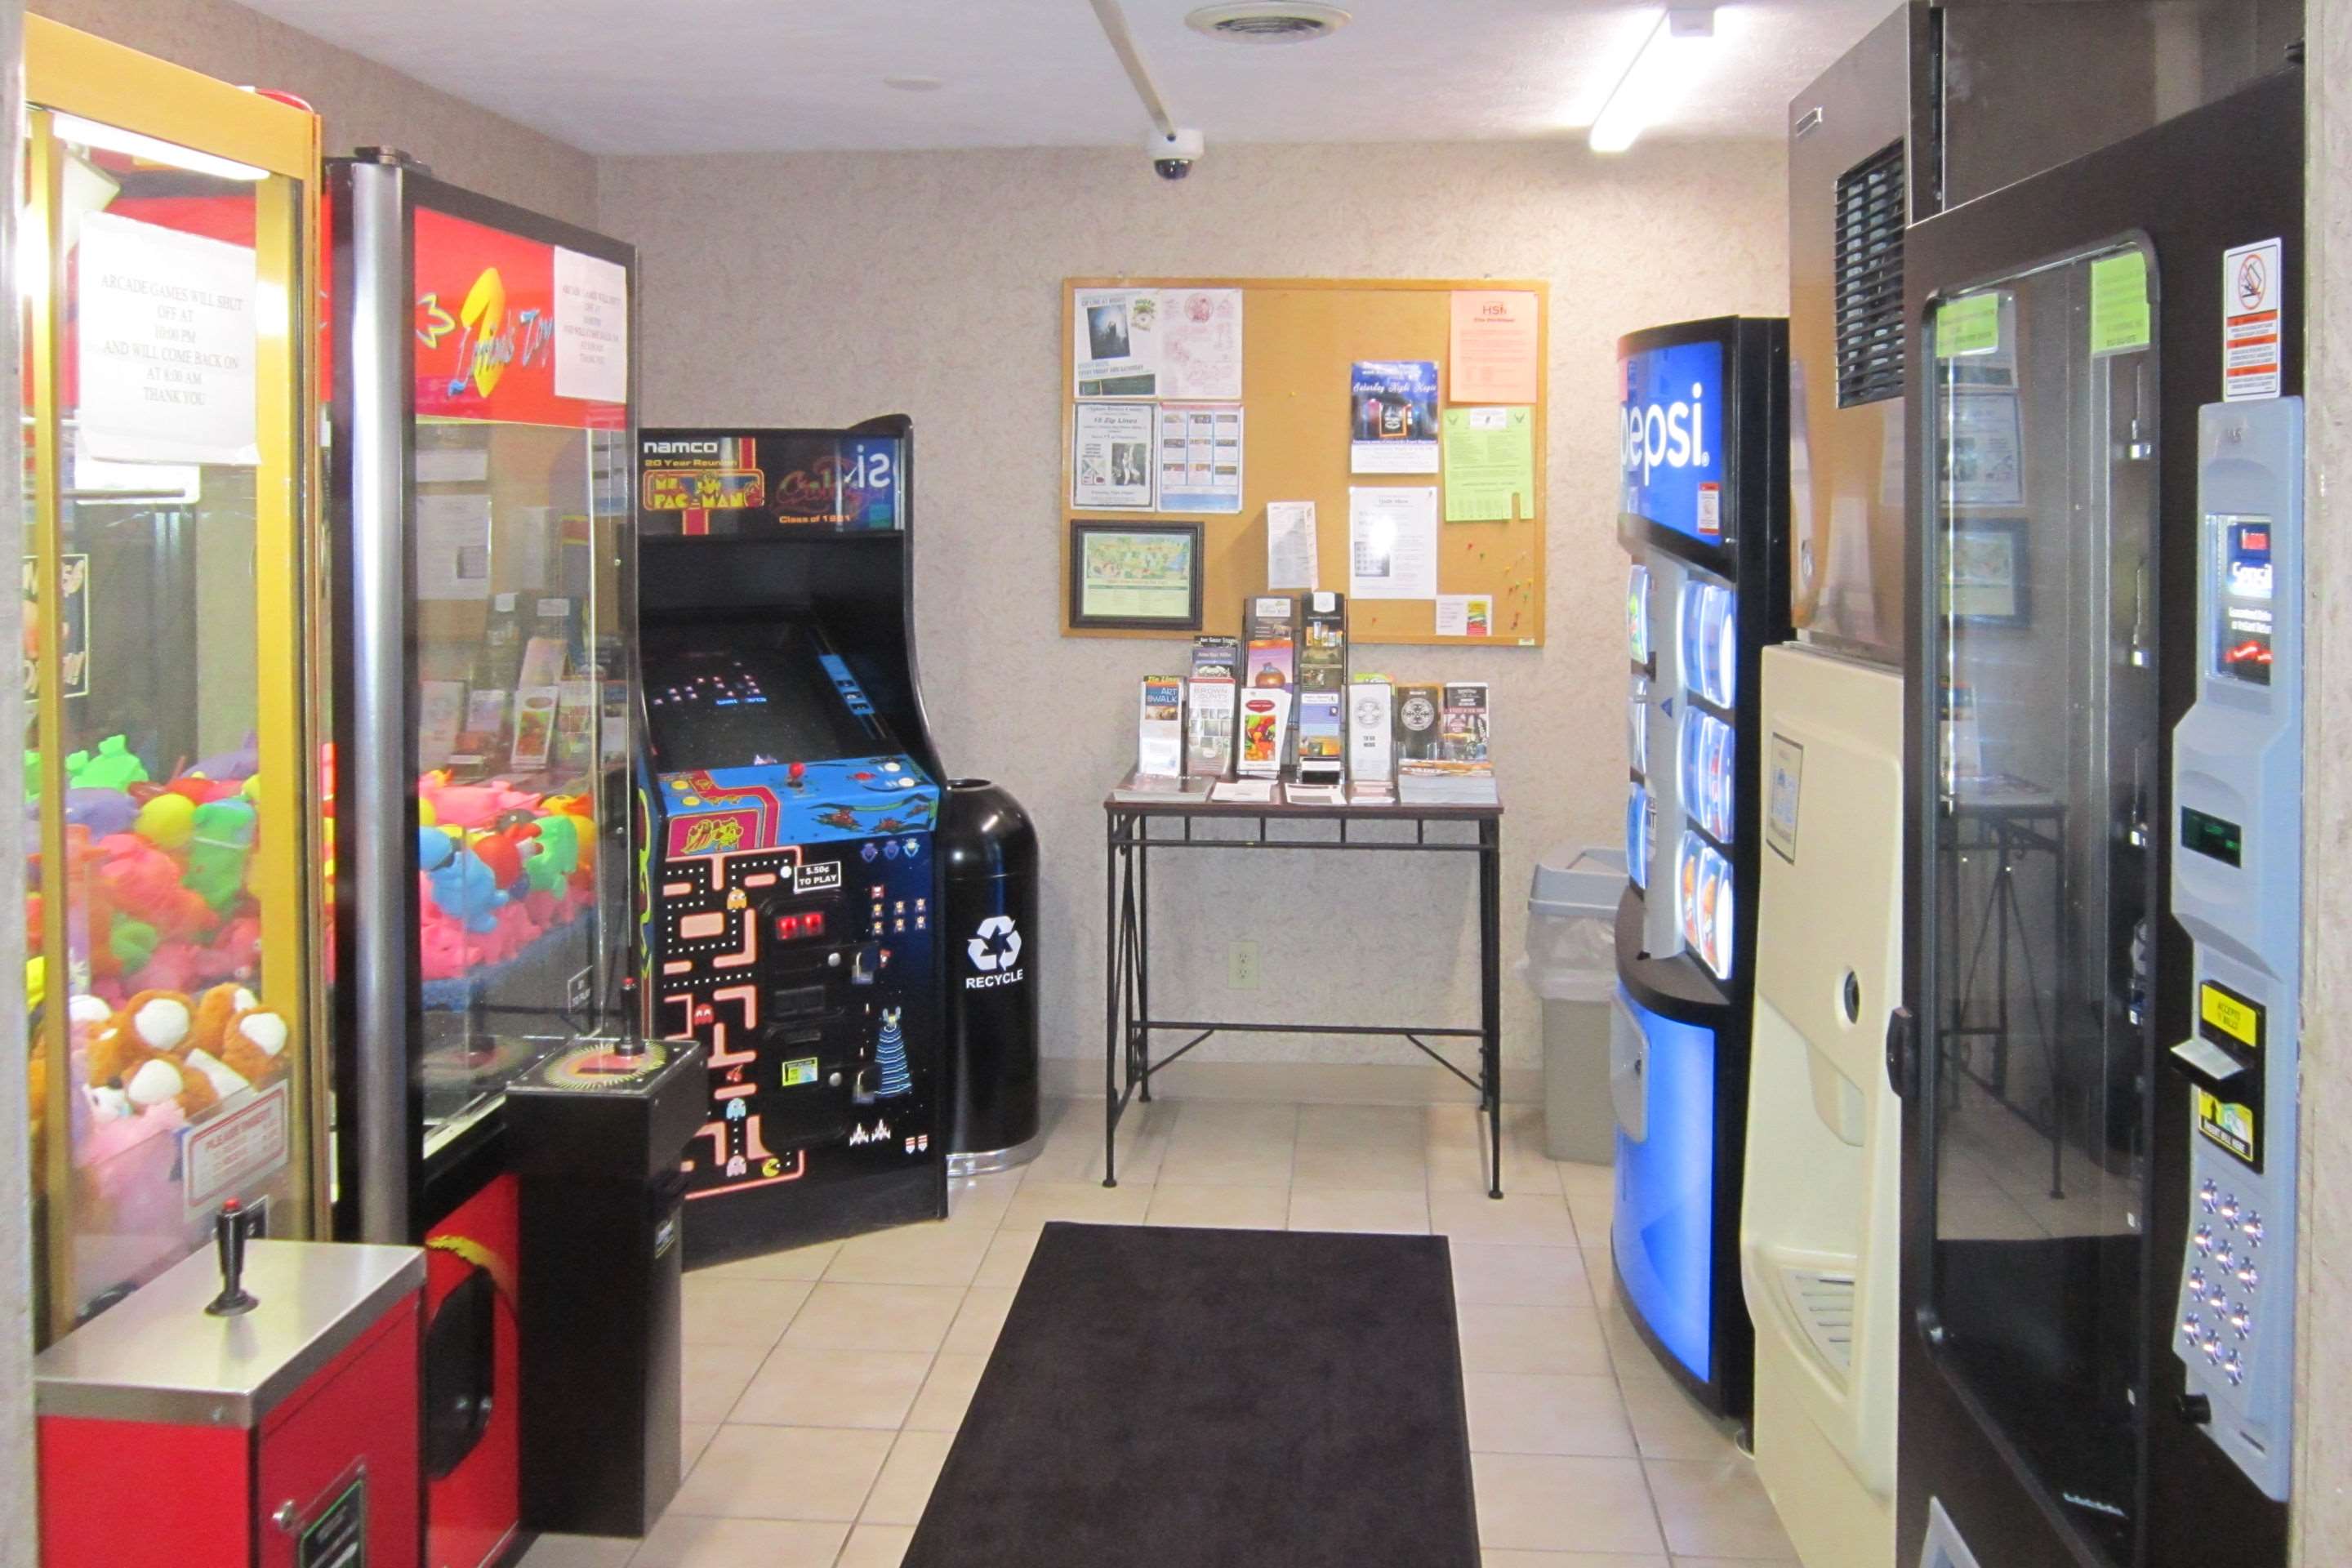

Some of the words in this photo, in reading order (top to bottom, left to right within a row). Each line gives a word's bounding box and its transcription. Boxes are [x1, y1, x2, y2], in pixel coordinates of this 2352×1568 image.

[100, 274, 149, 295] ARCADE
[150, 282, 189, 301] GAMES
[189, 288, 216, 307] WILL
[216, 295, 244, 311] SHUT
[157, 305, 177, 320] OFF
[181, 309, 194, 323] AT
[181, 329, 197, 344] PM
[104, 340, 129, 355] AND
[131, 342, 159, 359] WILL
[162, 347, 194, 363] COME
[194, 351, 222, 367] BACK
[223, 354, 238, 369] ON
[146, 367, 161, 381] AT
[185, 371, 203, 385] AM
[143, 386, 182, 403] THANK
[183, 390, 206, 406] YOU
[644, 441, 719, 454] namco
[654, 492, 746, 510] PAC-MAN
[778, 515, 808, 524] Class
[809, 515, 821, 523] of
[1153, 695, 1177, 703] WALK
[1160, 687, 1177, 695] ART
[813, 875, 837, 884] PLAY
[965, 969, 1024, 989] RECYCLE
